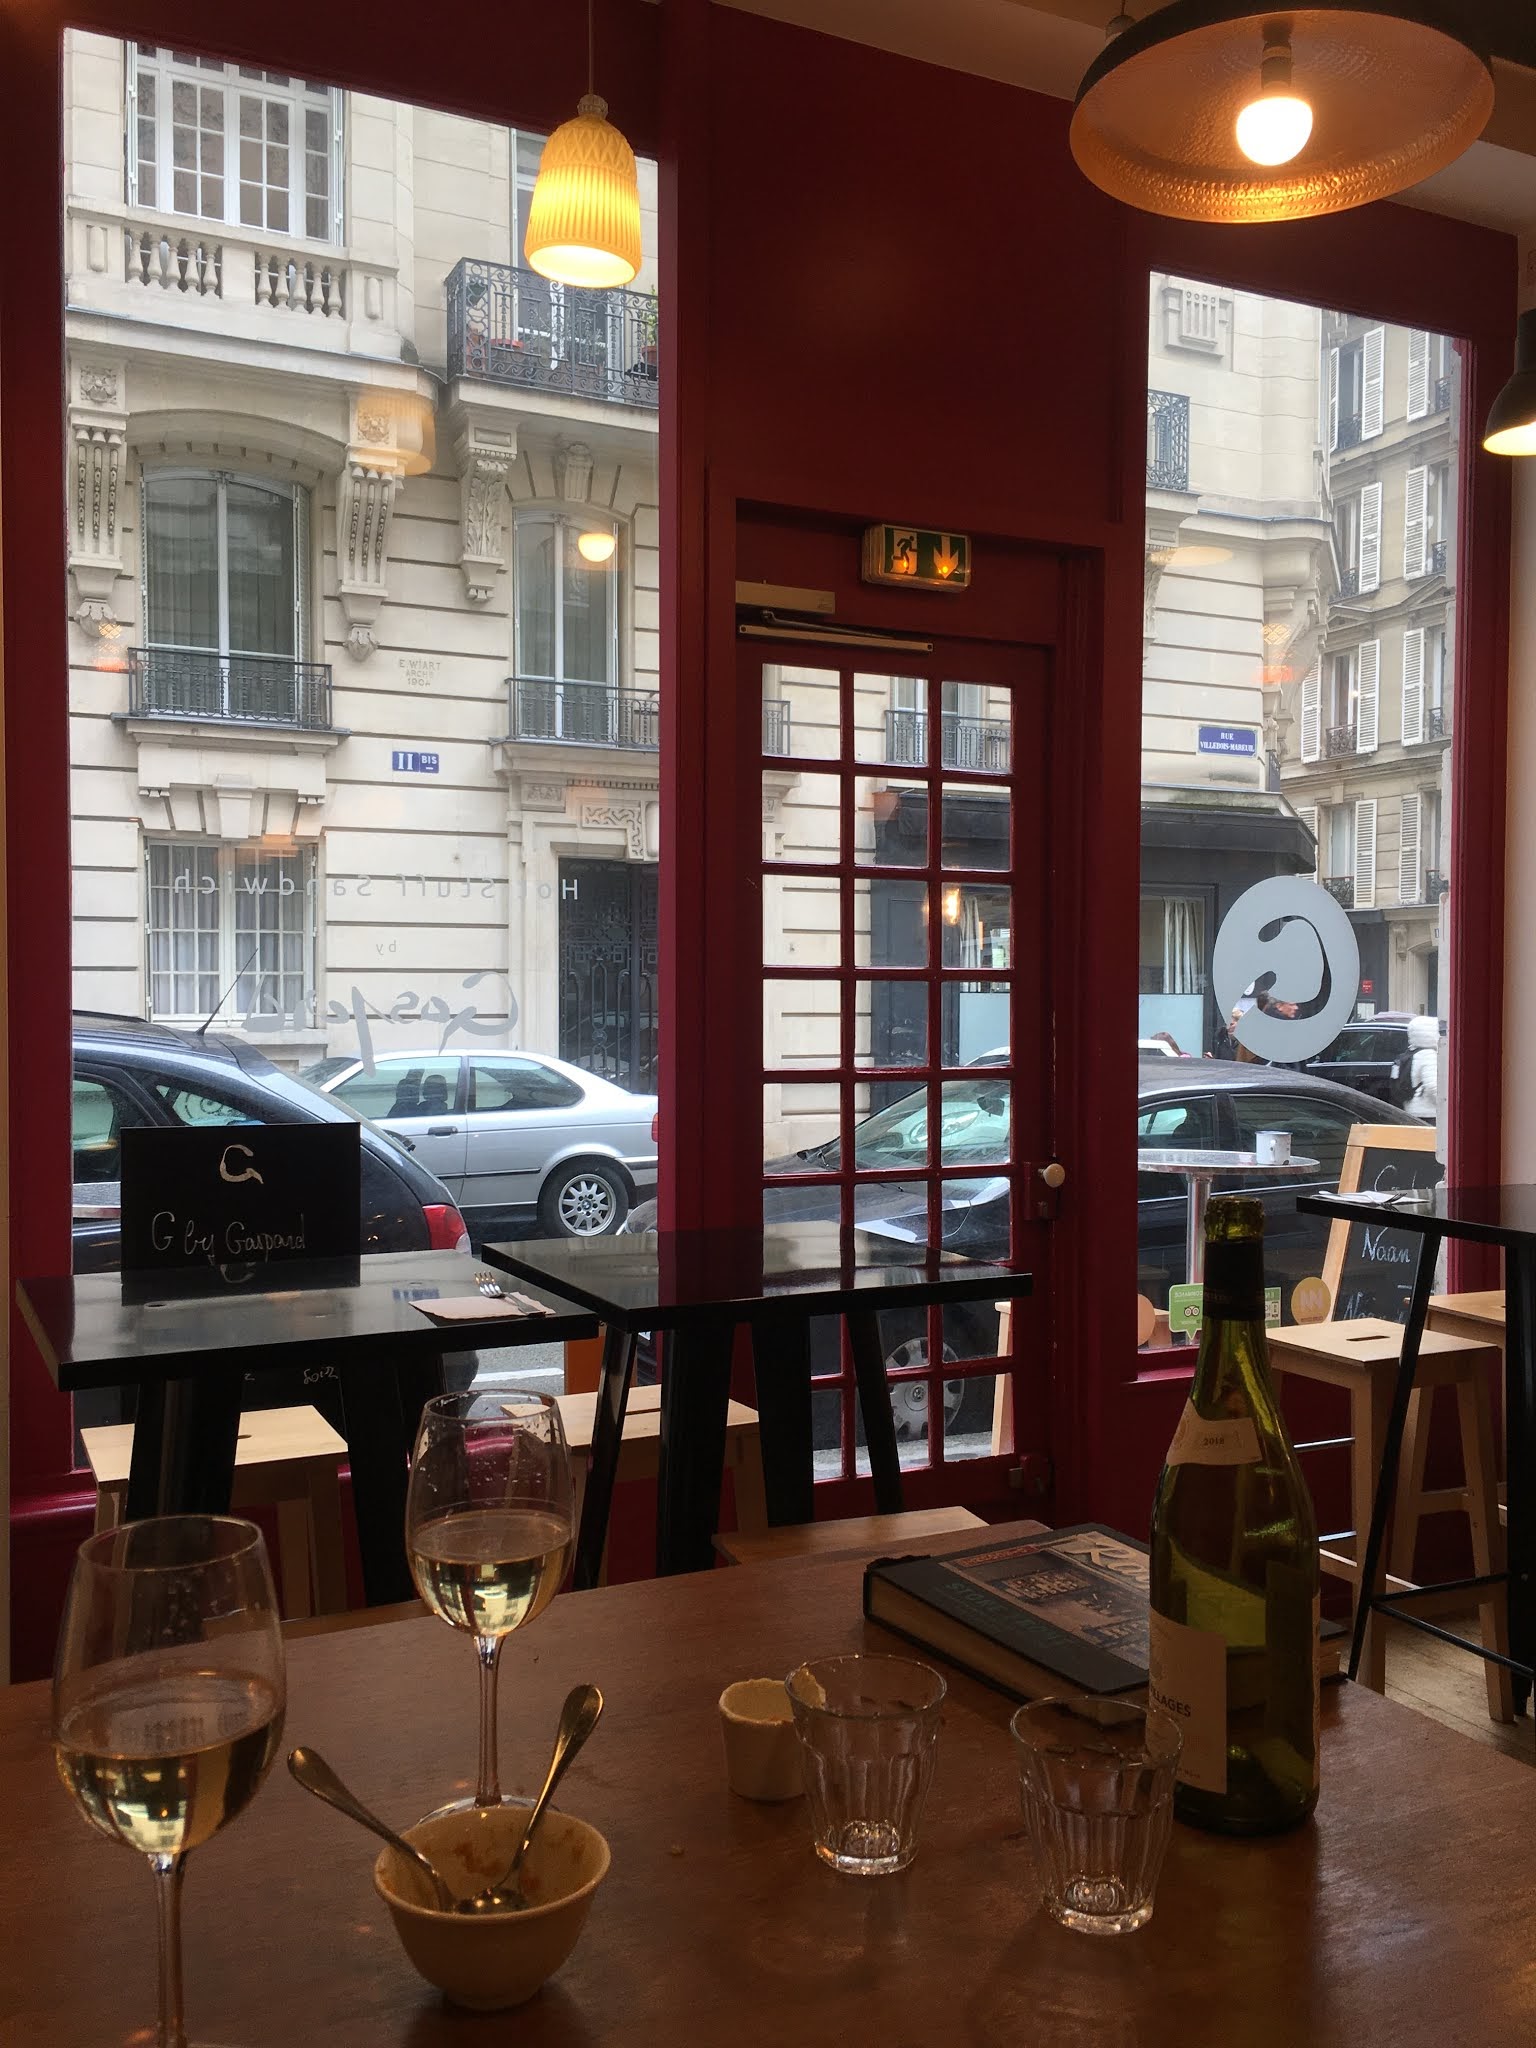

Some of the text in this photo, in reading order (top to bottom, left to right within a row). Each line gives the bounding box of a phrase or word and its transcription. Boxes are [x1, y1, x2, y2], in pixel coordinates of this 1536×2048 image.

[1220, 732, 1234, 740] RUE
[421, 755, 438, 765] BIS
[152, 1211, 306, 1266] G by Gaspard
[1201, 1437, 1225, 1447] 2018
[1150, 1684, 1191, 1718] ILLAGES
